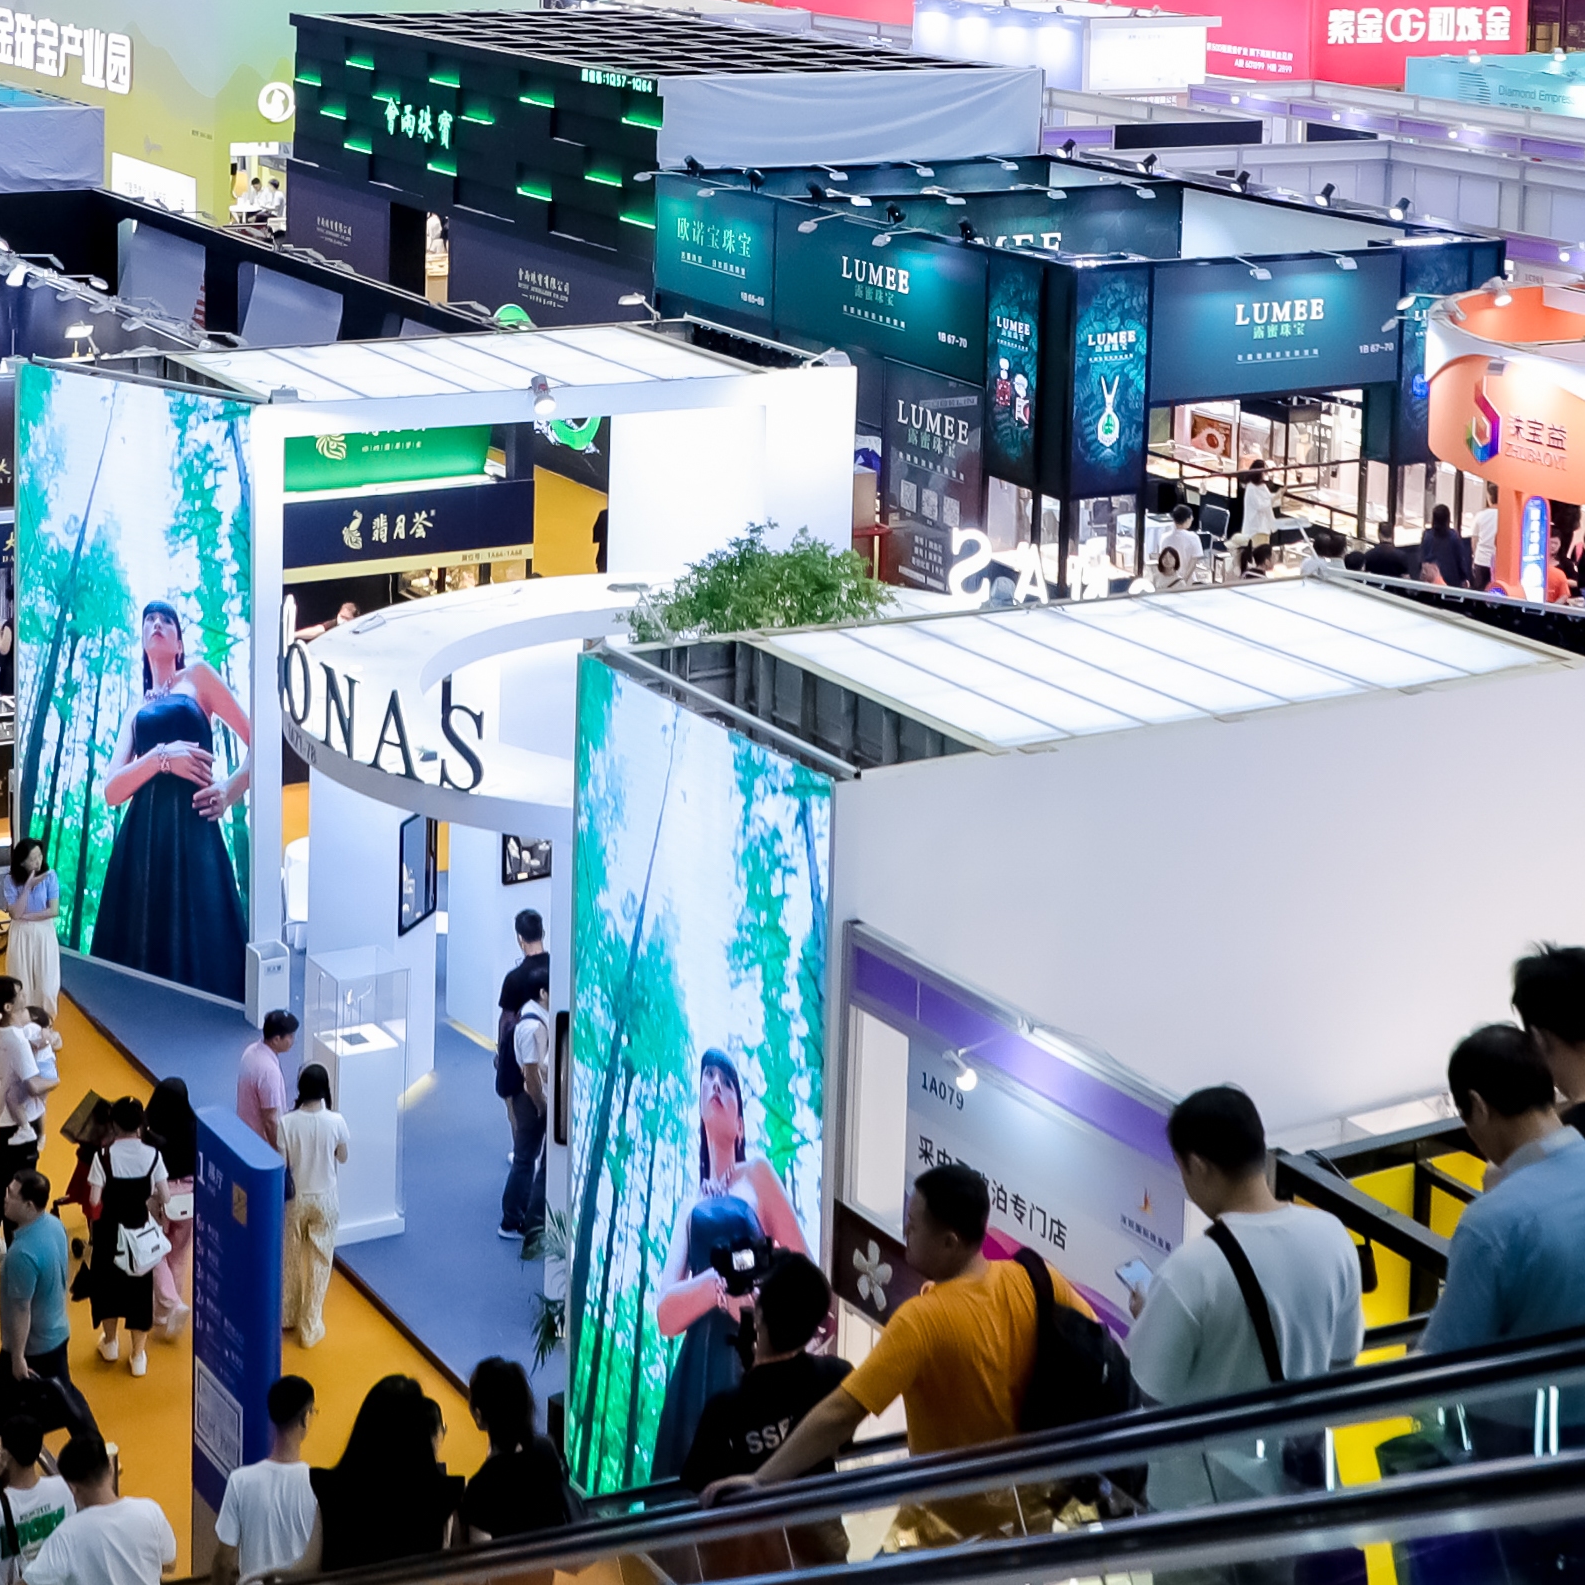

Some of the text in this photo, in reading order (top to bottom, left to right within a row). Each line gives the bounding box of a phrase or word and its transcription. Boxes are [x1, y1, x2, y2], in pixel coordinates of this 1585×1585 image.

[1498, 84, 1537, 100] Diamond
[841, 255, 910, 295] LUMEE
[996, 315, 1031, 335] LUMEE
[1235, 298, 1324, 326] LUMEE
[1087, 330, 1136, 346] LUMEE
[897, 399, 970, 446] LUMEE
[371, 510, 434, 544] 翡月荟
[922, 1071, 964, 1111] 1A079
[198, 1151, 205, 1186] 1
